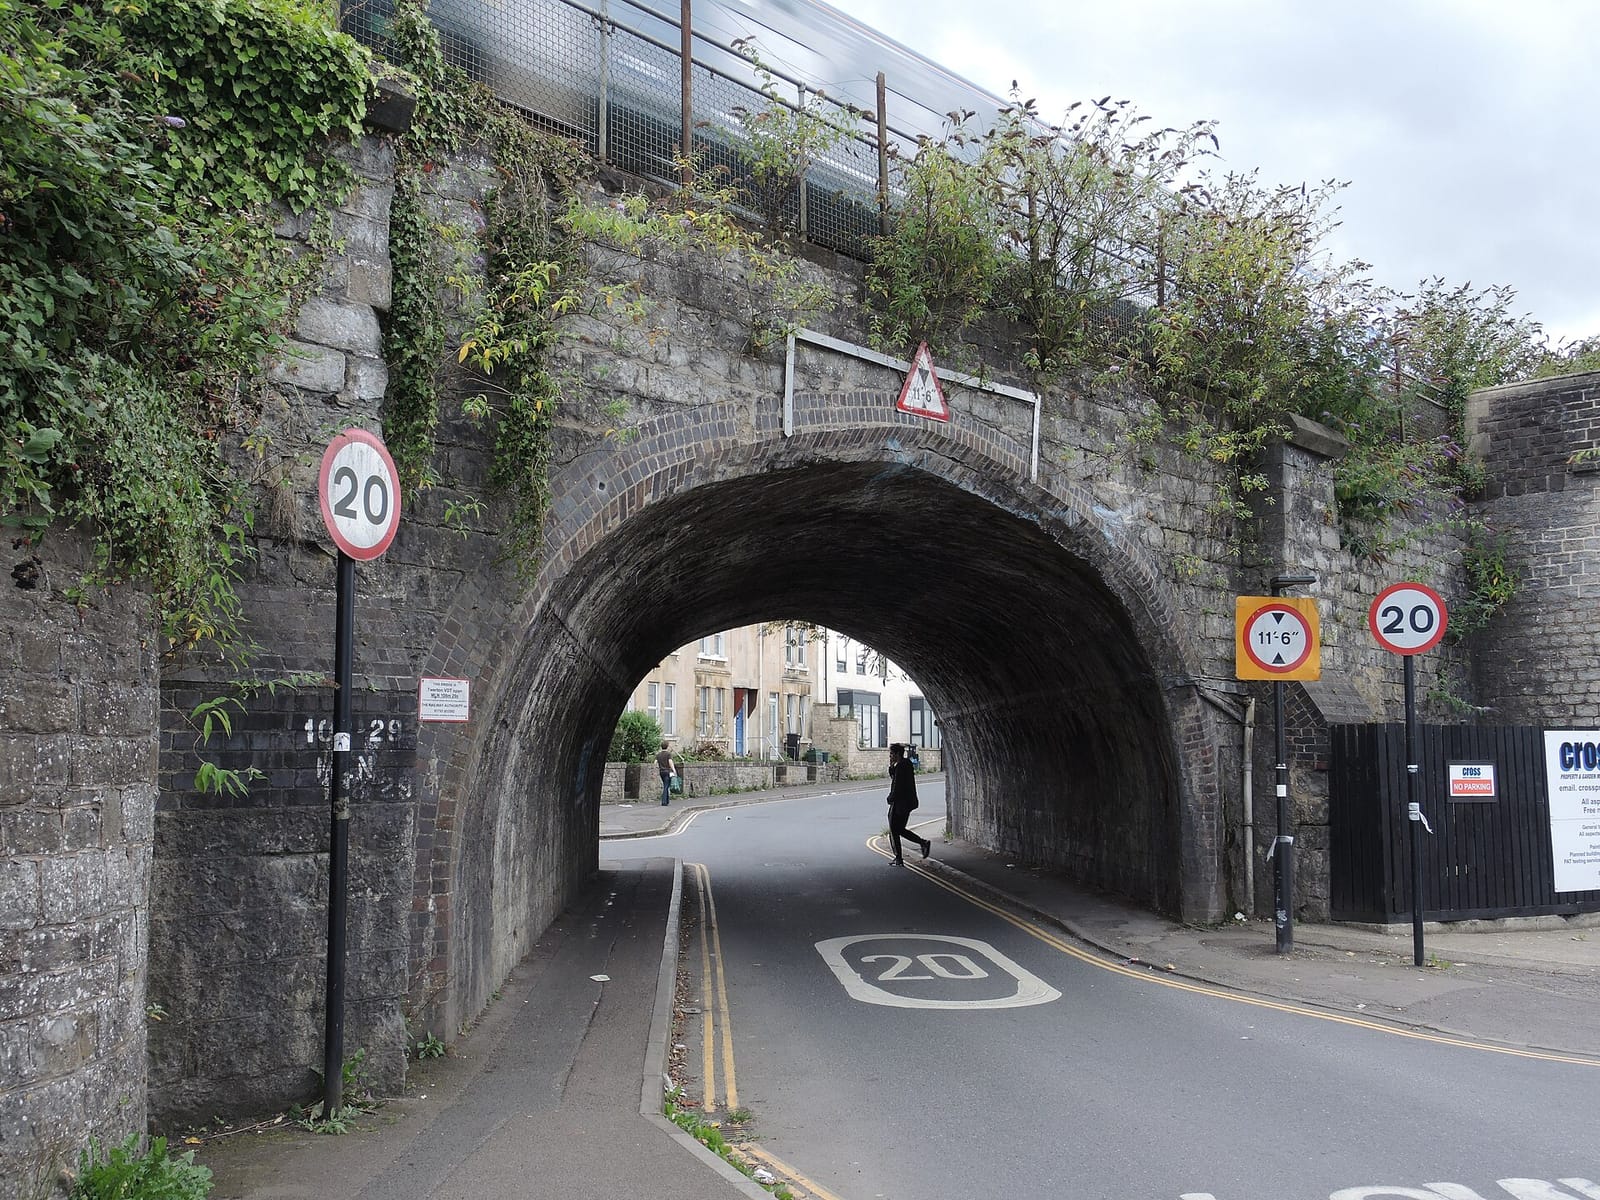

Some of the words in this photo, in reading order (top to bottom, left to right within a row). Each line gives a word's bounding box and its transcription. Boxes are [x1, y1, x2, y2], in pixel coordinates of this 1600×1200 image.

[334, 466, 388, 525] 20
[1381, 605, 1434, 634] 20
[369, 719, 402, 742] 29
[1559, 742, 1600, 772] cro
[1462, 767, 1481, 776] cross
[1453, 783, 1464, 791] NO
[1464, 783, 1491, 791] PARKING
[1583, 806, 1596, 814] Free
[861, 954, 989, 981] 20
